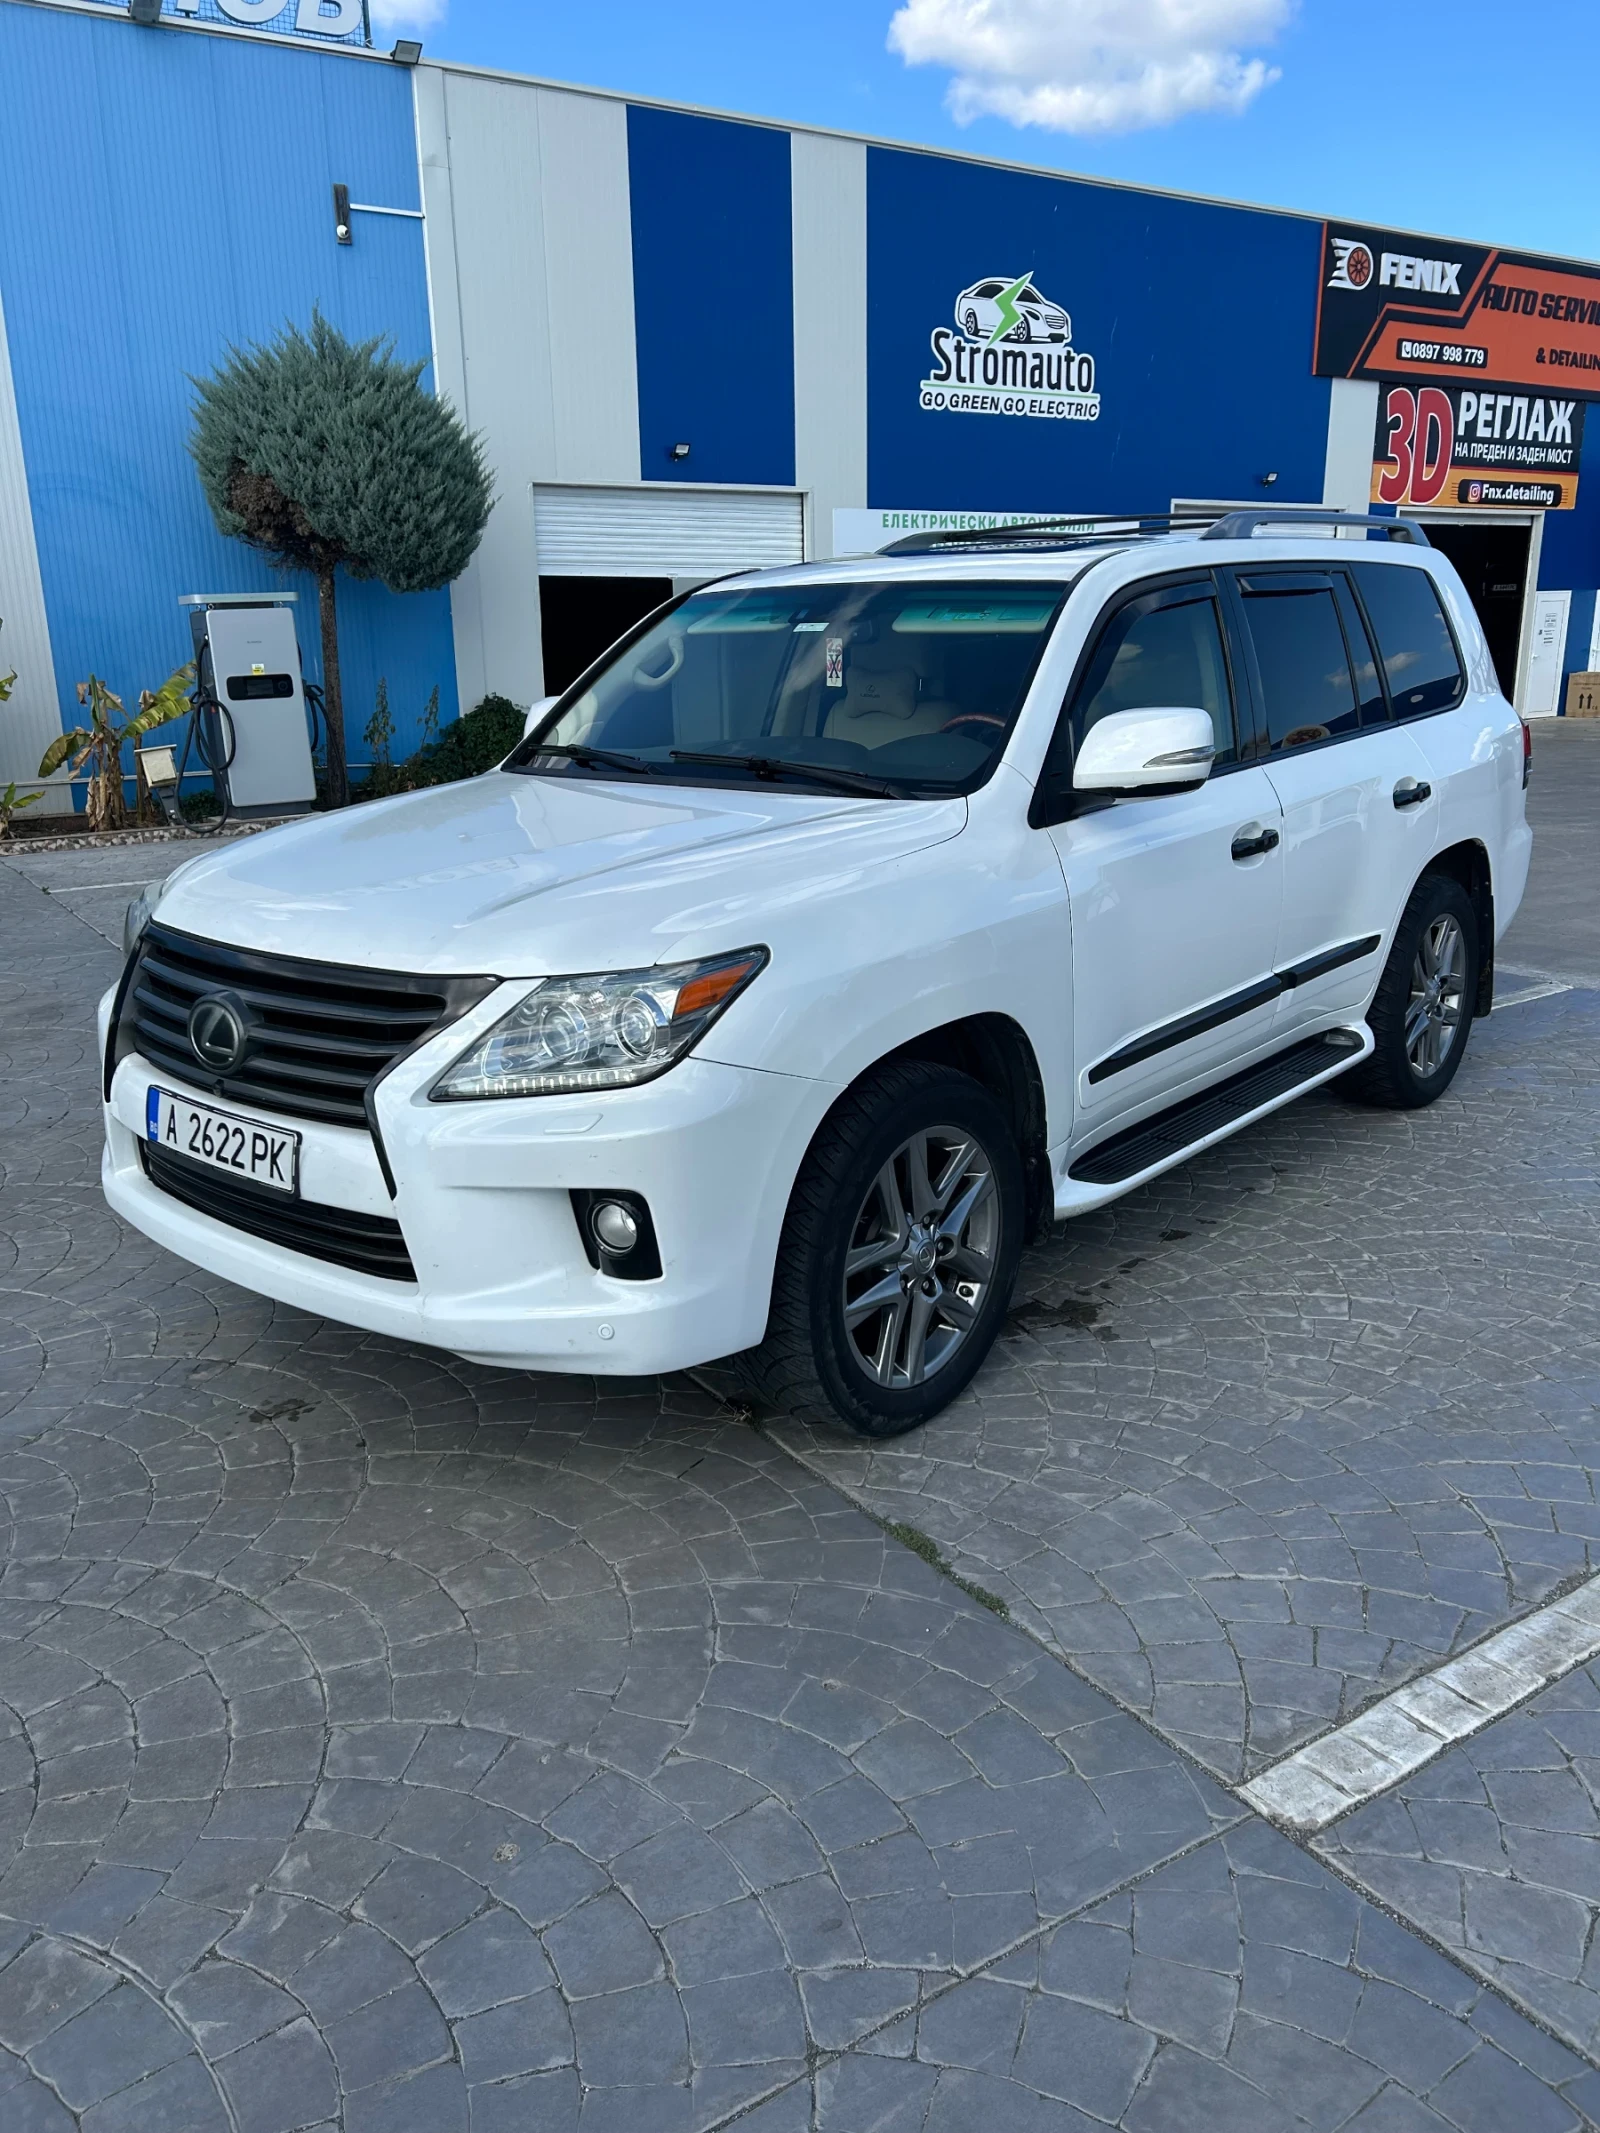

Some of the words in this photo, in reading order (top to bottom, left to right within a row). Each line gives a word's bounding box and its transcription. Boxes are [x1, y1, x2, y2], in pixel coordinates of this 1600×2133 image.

[1379, 252, 1462, 295] FENIX
[1481, 283, 1539, 316] AUTO
[933, 330, 1093, 393] Stromauto
[1412, 342, 1440, 360] 0897
[1442, 344, 1462, 362] 998
[1464, 347, 1484, 364] 779
[1535, 347, 1546, 364] &
[922, 391, 945, 407] GO
[949, 393, 1000, 412] GREEN
[1003, 397, 1025, 413] GO
[1029, 399, 1098, 418] ELECTRIC
[1457, 391, 1576, 444] РЕГЛАЖ
[1378, 387, 1454, 505] 3D
[1454, 442, 1468, 458] НА
[1470, 443, 1507, 463] ПРЕДЕН
[1507, 445, 1515, 460] И
[1516, 446, 1546, 464] ЗАДЕН
[1547, 449, 1573, 464] МОСТ
[1481, 483, 1554, 504] Fnx.detailing
[882, 513, 997, 529] ЕЛЕКТРИЧЕСКИ
[166, 1104, 177, 1144] A
[188, 1113, 246, 1170] 2622
[251, 1132, 287, 1182] PK
